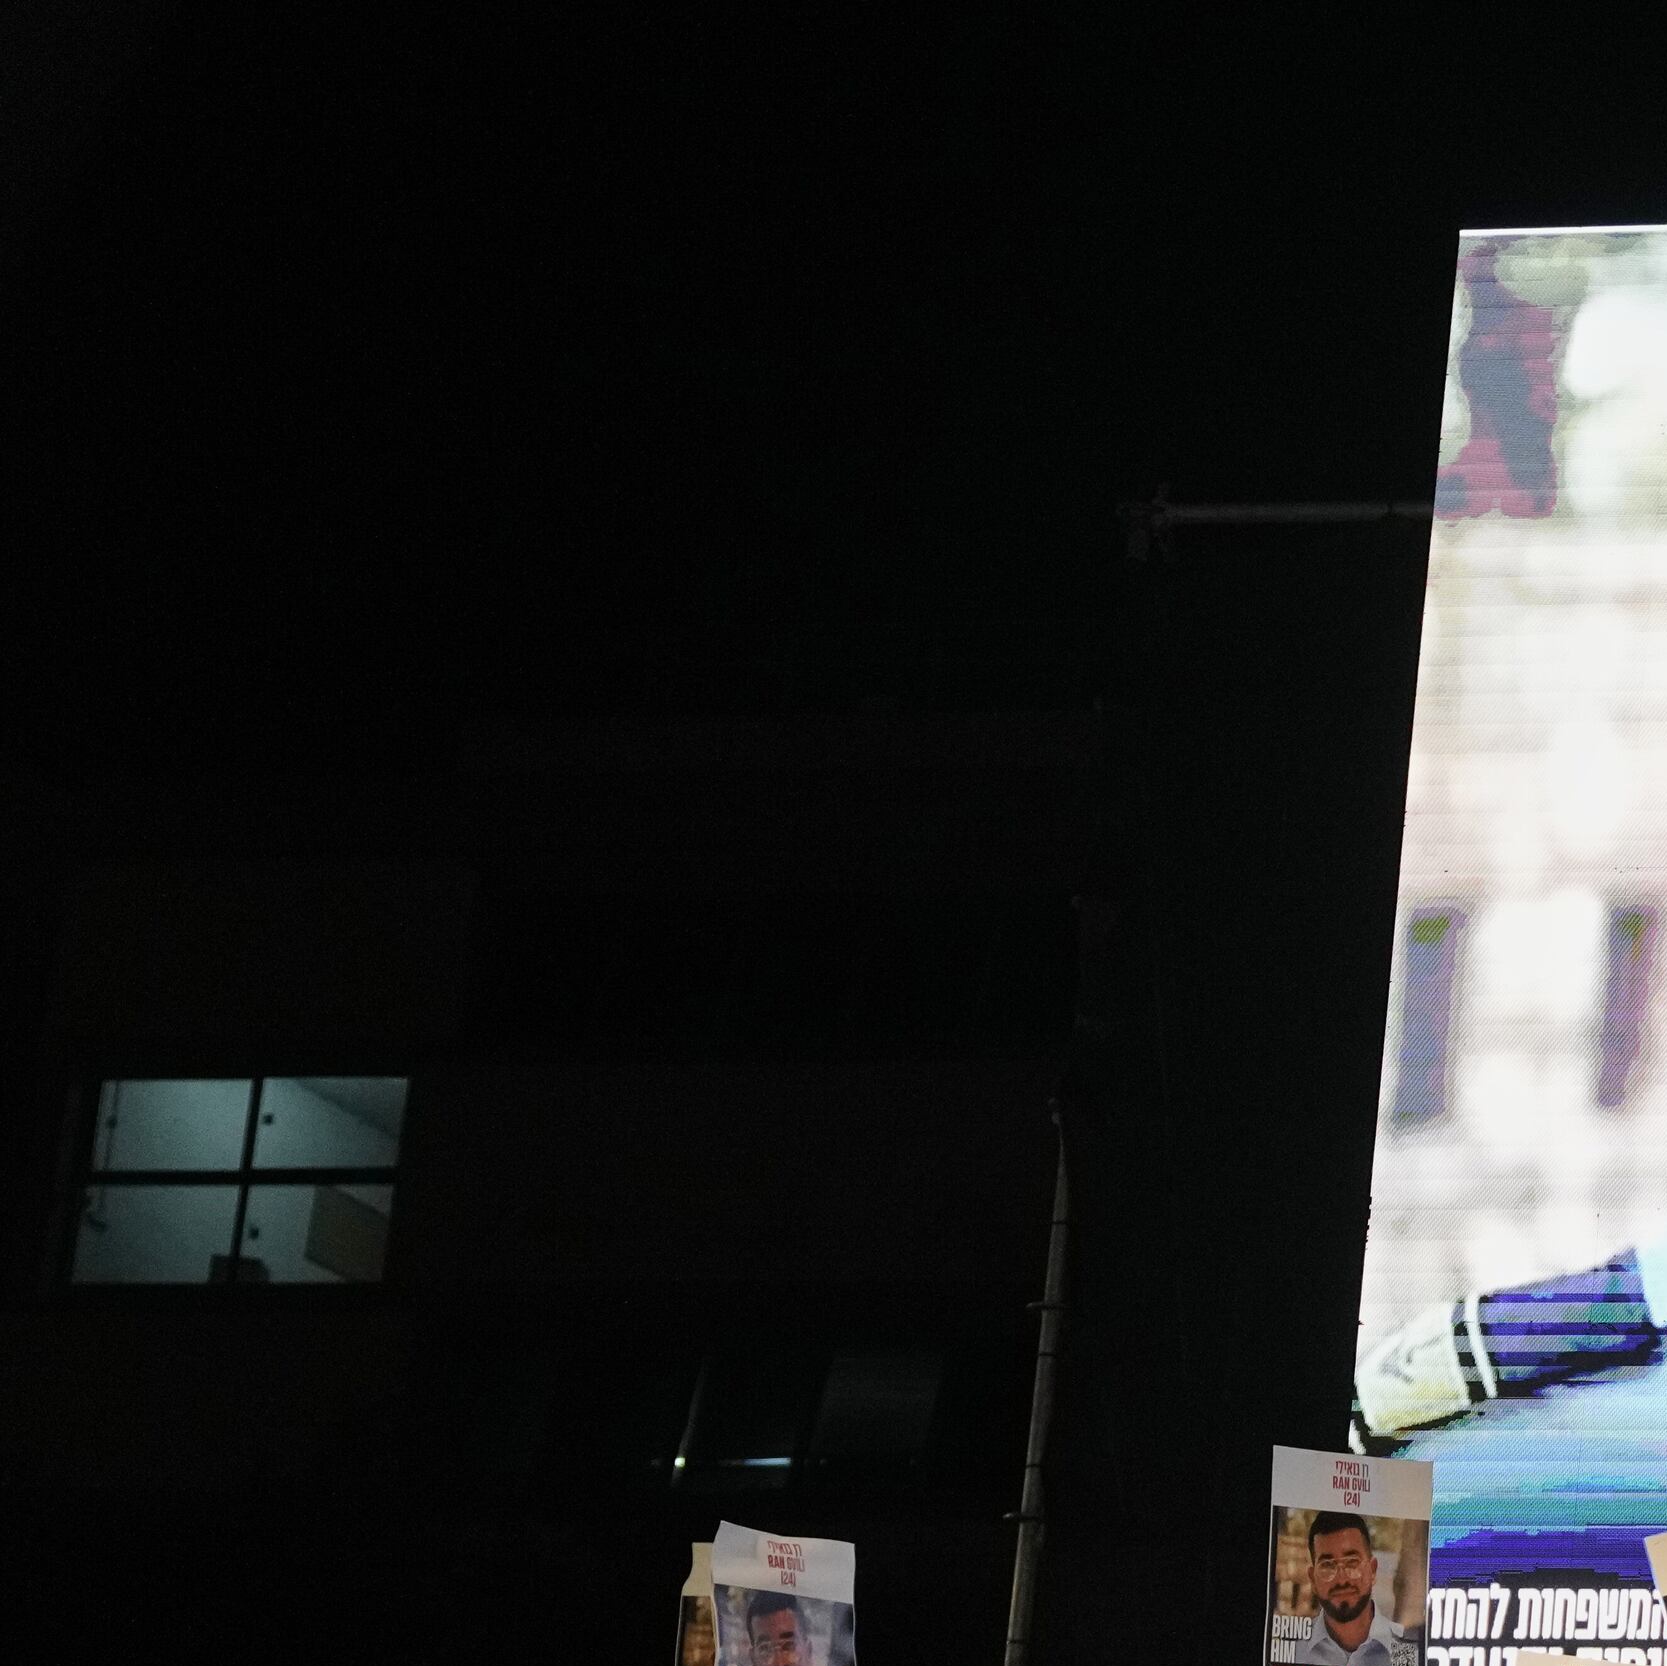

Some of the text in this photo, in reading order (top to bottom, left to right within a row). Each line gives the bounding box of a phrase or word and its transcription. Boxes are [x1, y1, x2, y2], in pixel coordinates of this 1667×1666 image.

[1427, 1582, 1511, 1640] להחז
[1271, 1614, 1313, 1640] BRING
[1271, 1639, 1297, 1663] HIM
